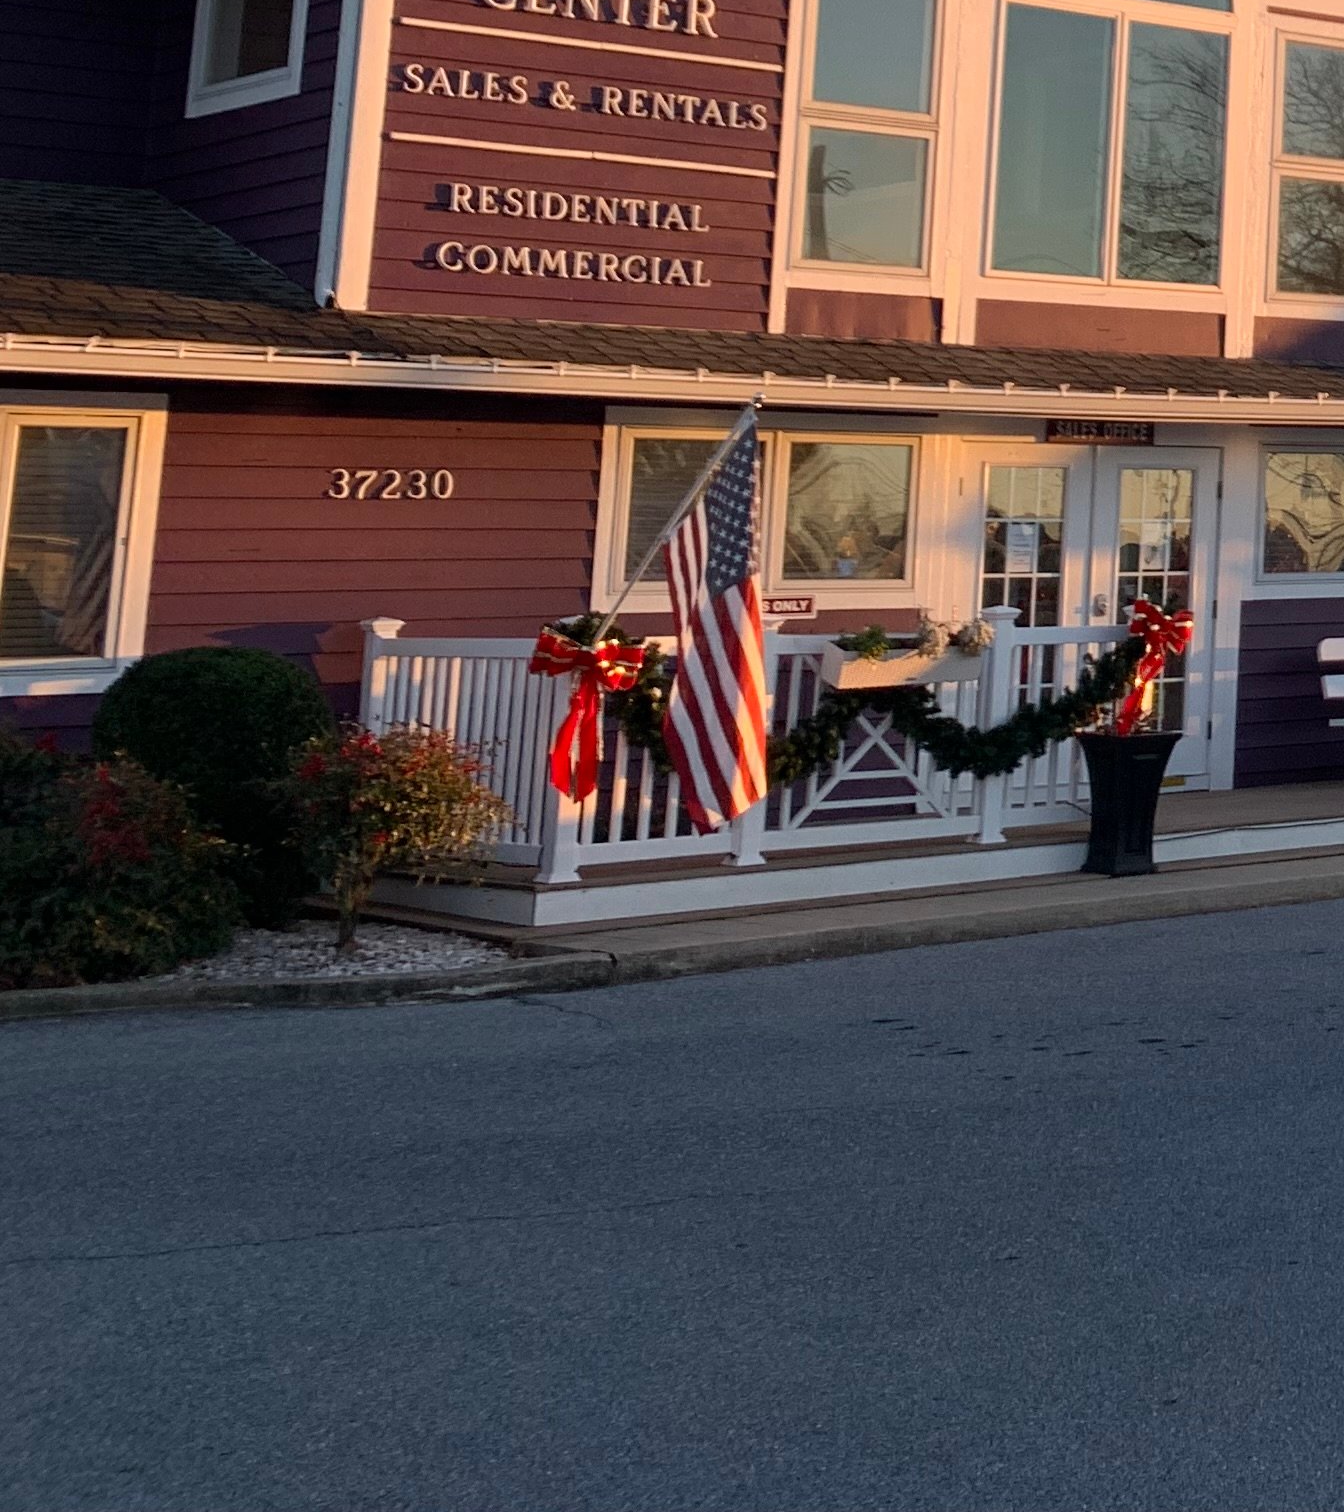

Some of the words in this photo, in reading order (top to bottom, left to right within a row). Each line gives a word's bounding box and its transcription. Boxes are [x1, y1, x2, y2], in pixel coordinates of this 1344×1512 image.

[402, 63, 529, 105] SALES
[549, 80, 576, 111] &
[601, 86, 768, 131] RENTALS
[450, 182, 710, 232] RESIDENTIAL
[436, 241, 712, 287] COMMERCIAL
[329, 468, 454, 499] 37230
[772, 599, 809, 611] ONLY
